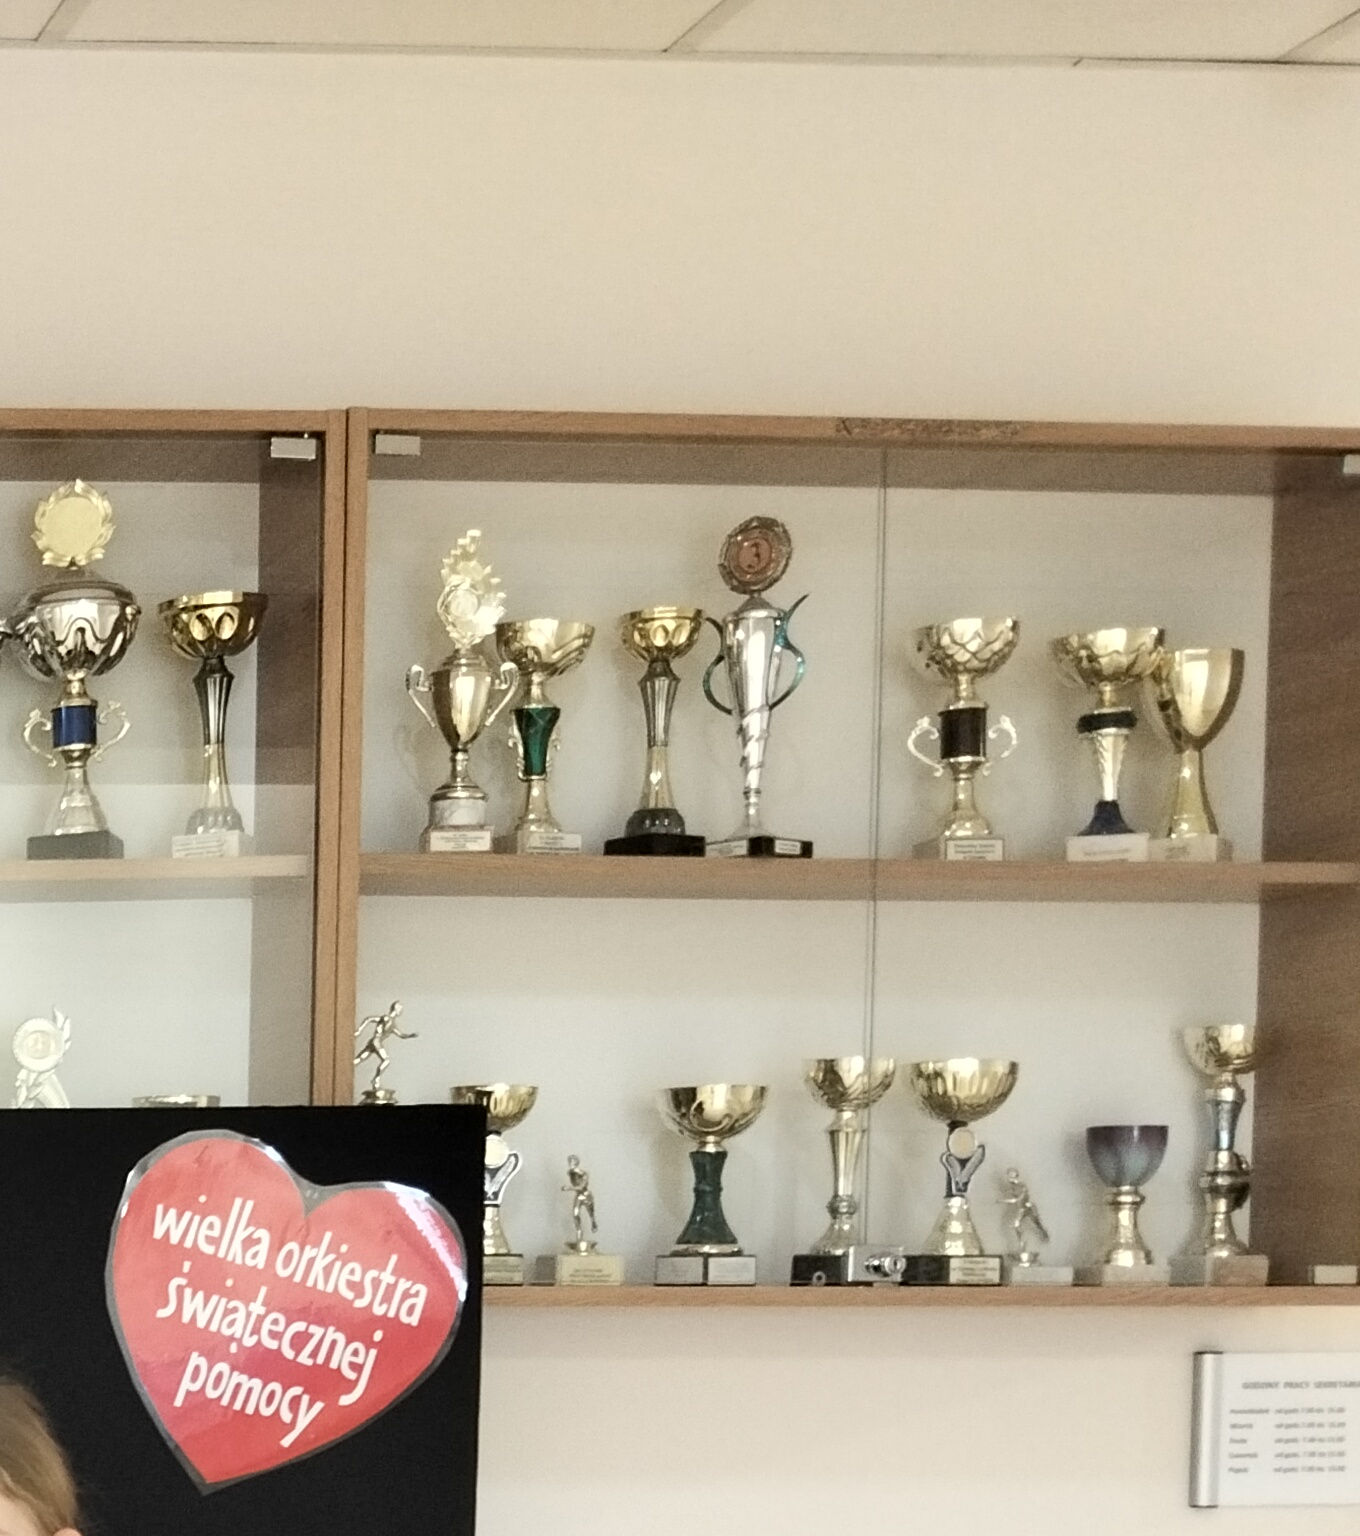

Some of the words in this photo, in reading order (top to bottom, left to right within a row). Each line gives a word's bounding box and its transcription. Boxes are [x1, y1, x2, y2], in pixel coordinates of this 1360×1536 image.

[153, 1195, 270, 1269] wielka
[275, 1231, 428, 1327] orkiestra
[156, 1260, 383, 1406] świątecznej
[173, 1351, 325, 1447] pomocy
